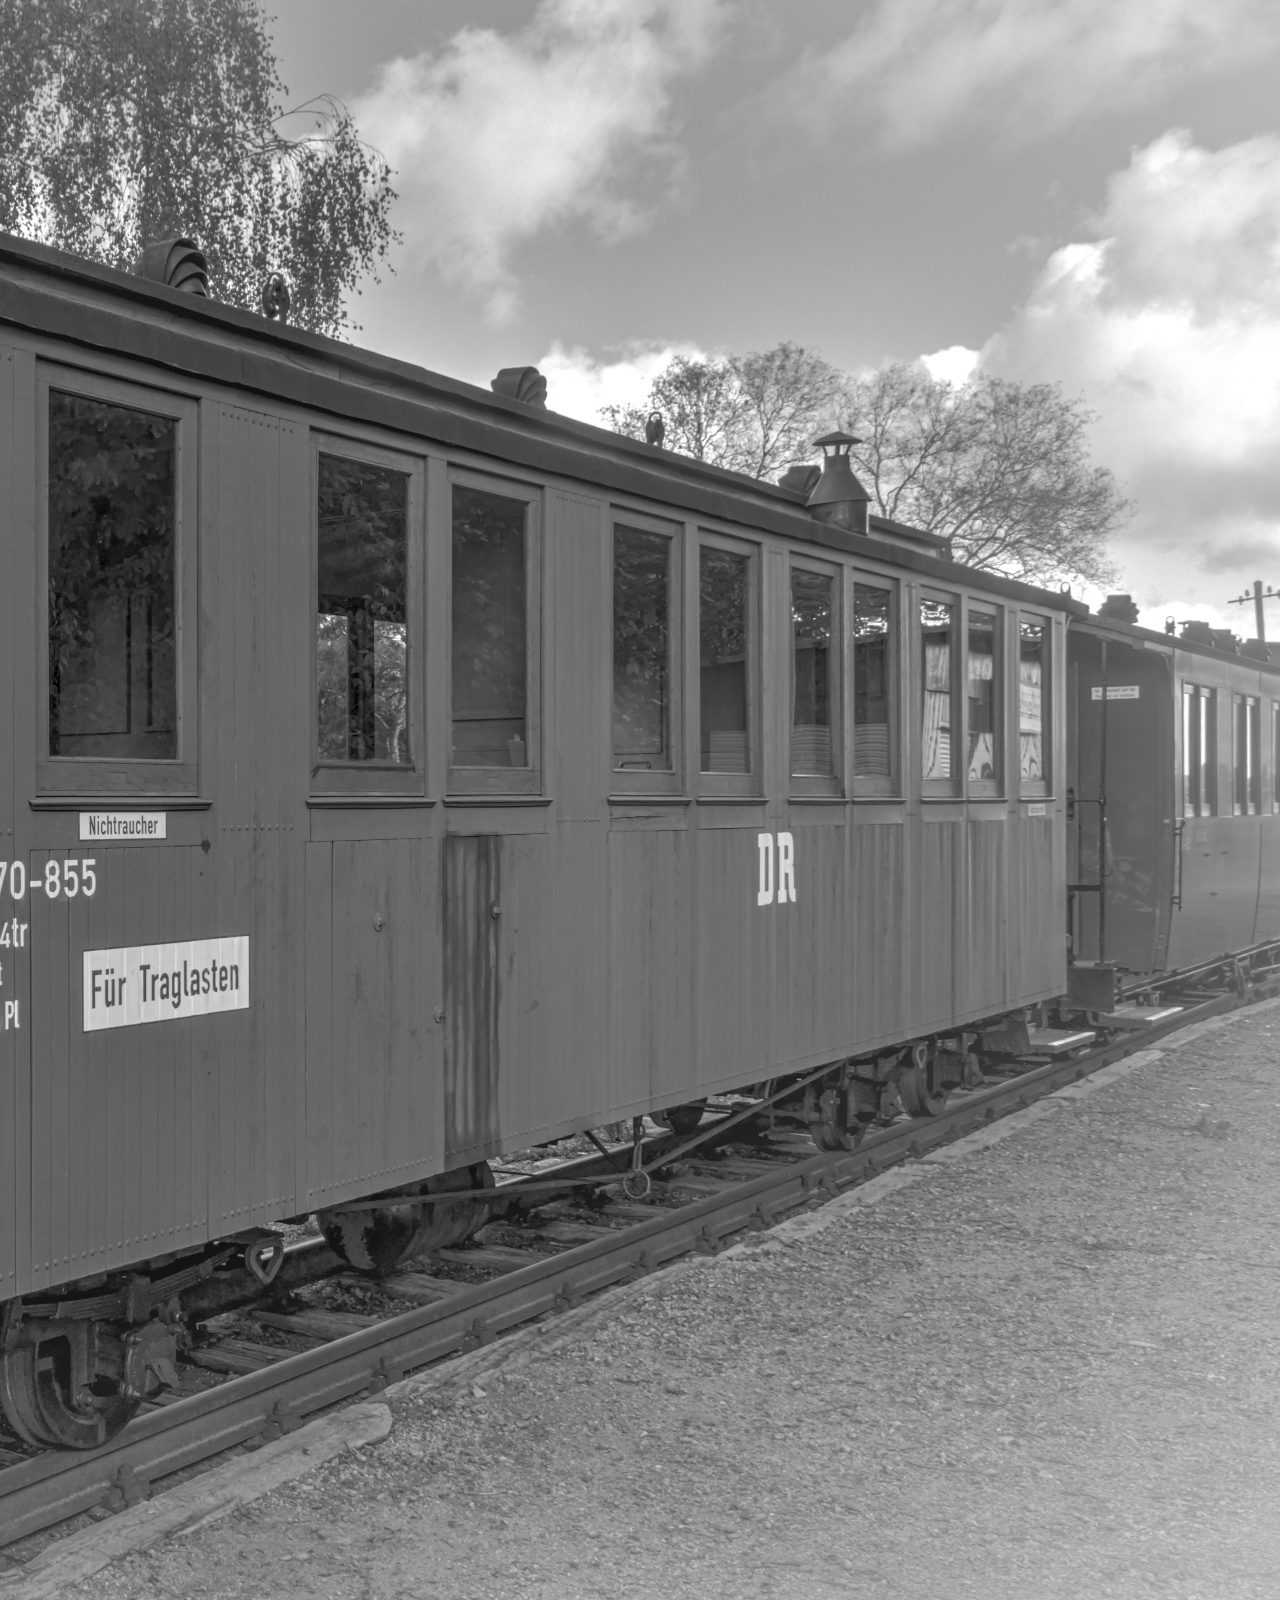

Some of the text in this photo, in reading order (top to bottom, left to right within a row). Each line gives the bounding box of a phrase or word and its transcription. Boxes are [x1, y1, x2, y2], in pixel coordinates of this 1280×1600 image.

[89, 815, 158, 836] Nichtraucher
[758, 832, 796, 906] DR
[91, 959, 239, 1009] Für Traglasten
